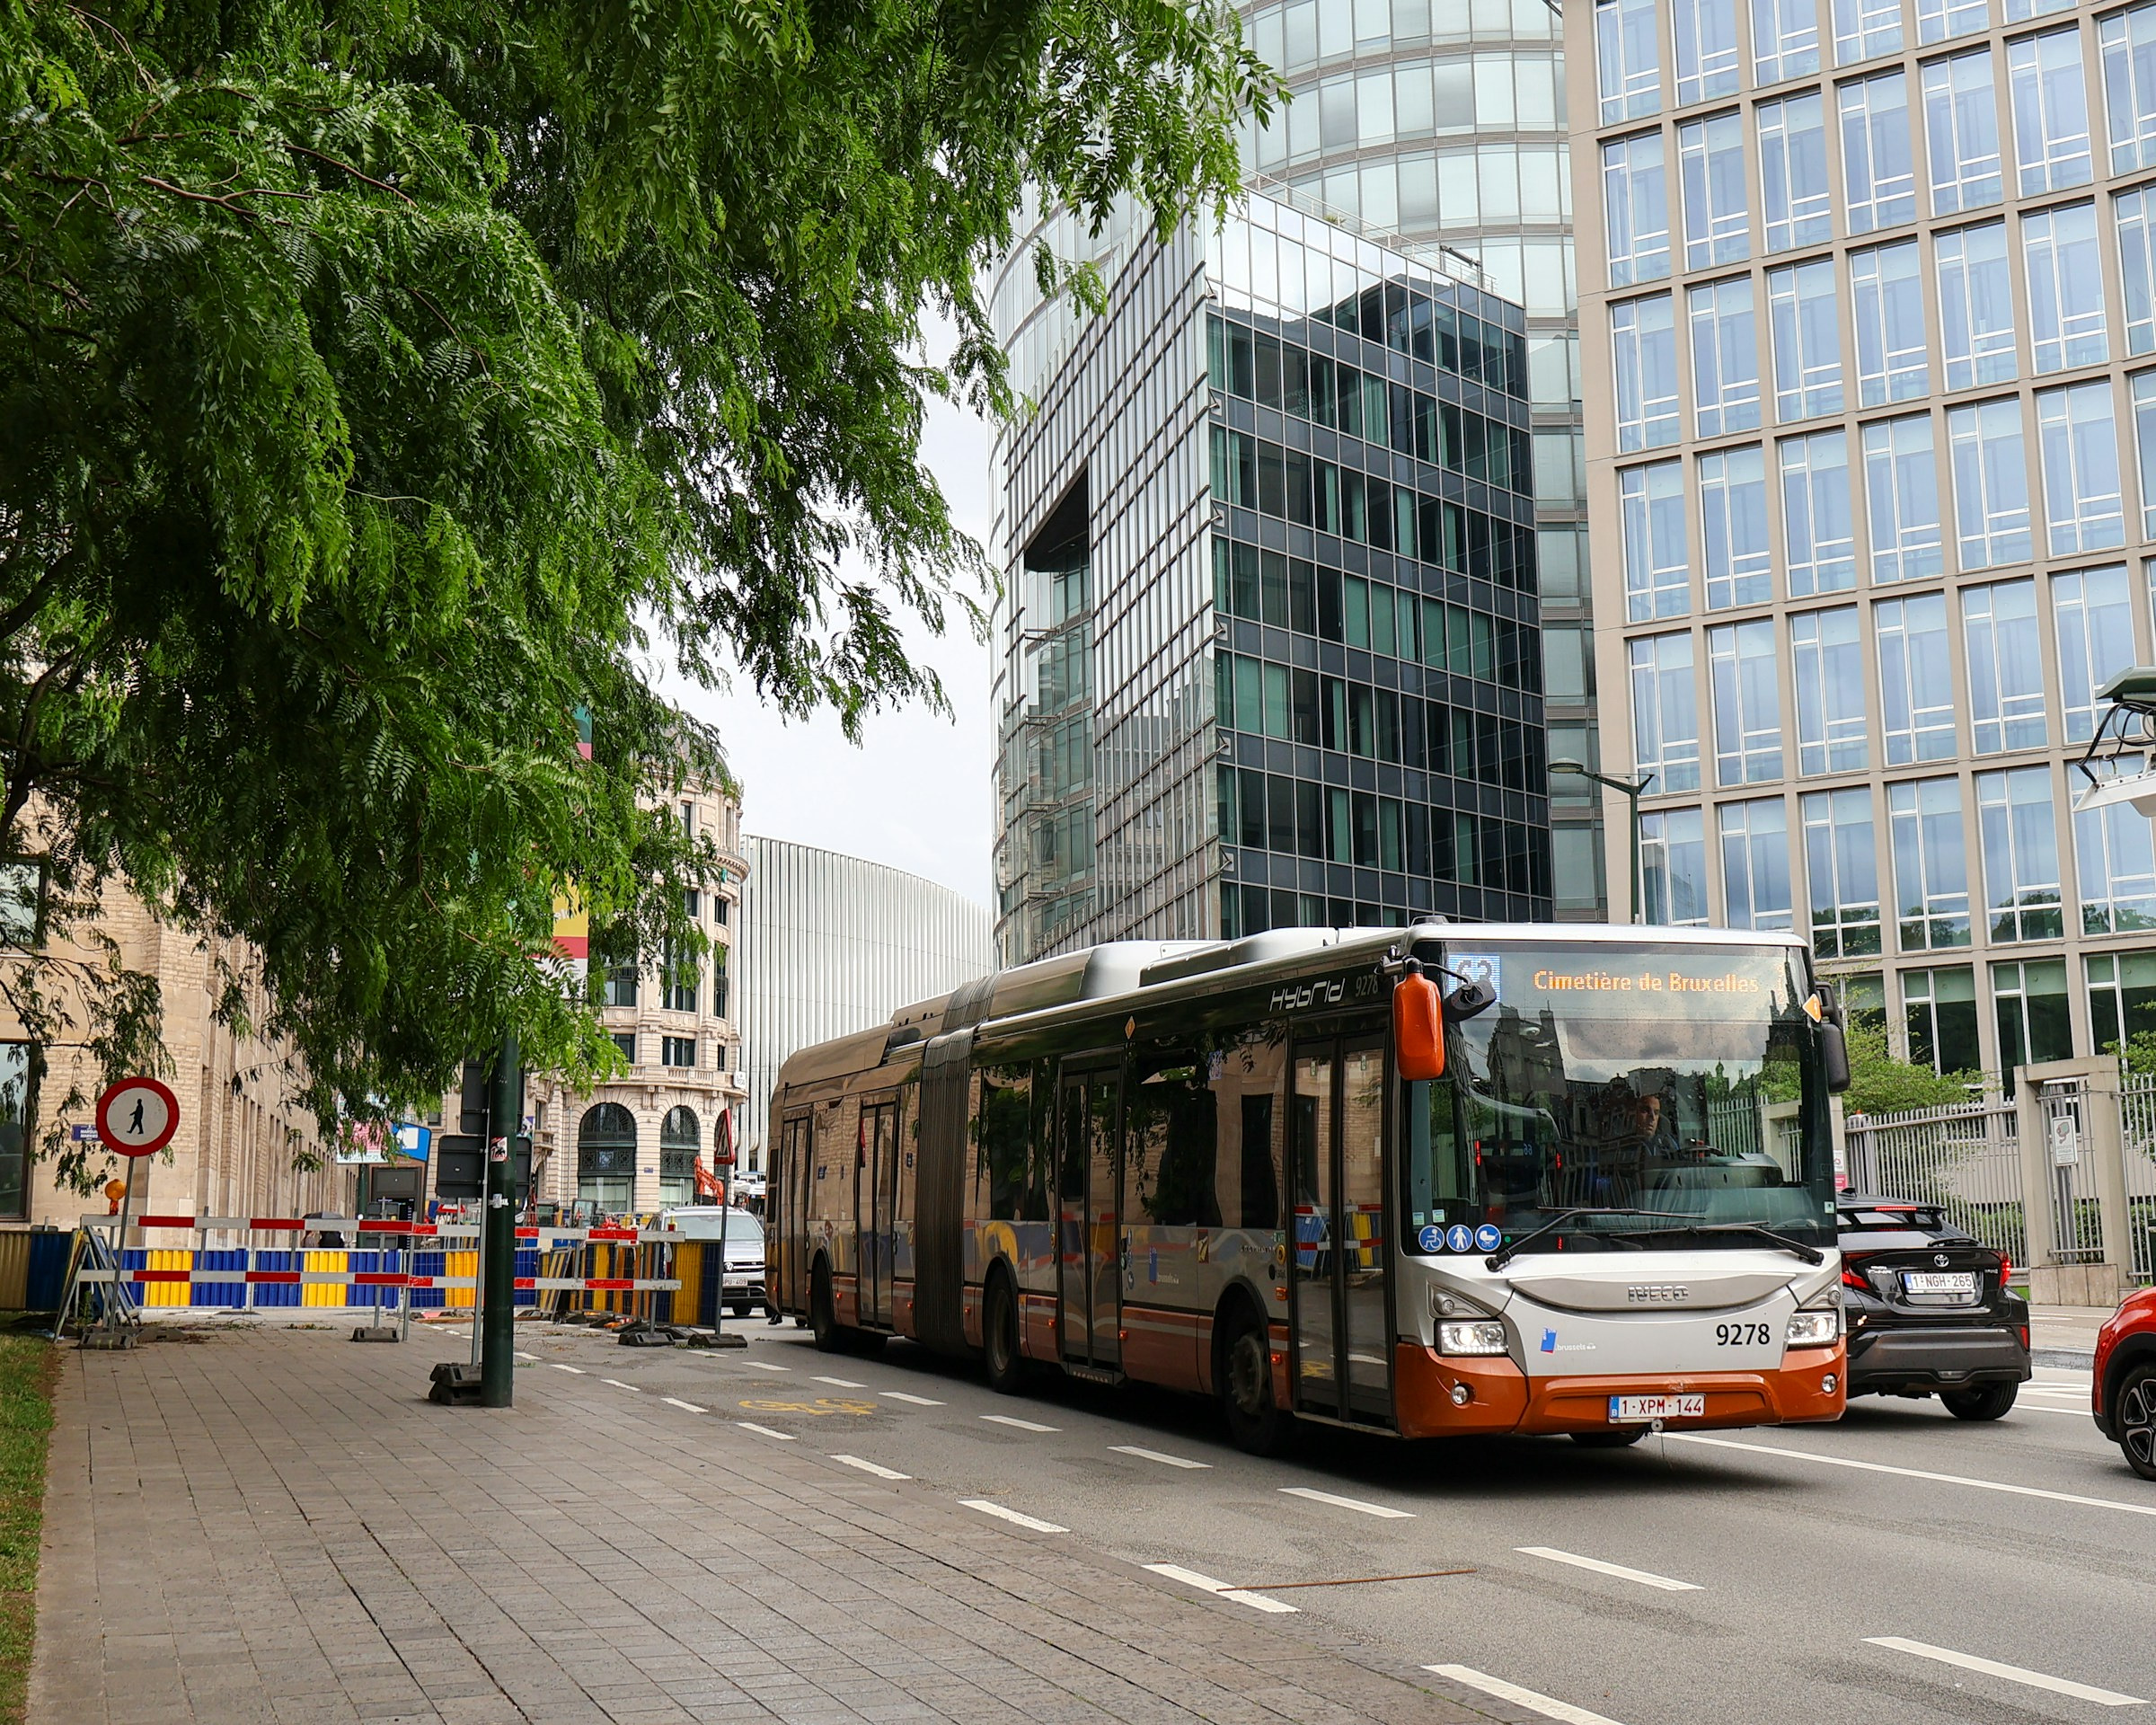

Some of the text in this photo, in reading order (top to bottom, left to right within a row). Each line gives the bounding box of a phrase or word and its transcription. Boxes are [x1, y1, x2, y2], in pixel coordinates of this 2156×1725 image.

[1355, 975, 1379, 997] 9278
[1534, 970, 1759, 992] Cimetière de Bruxelles
[1913, 1274, 1972, 1287] 1-NGH-265
[1628, 1285, 1689, 1302] IVECO
[1716, 1323, 1771, 1346] 9278
[1622, 1398, 1701, 1415] 1-XPM-144
